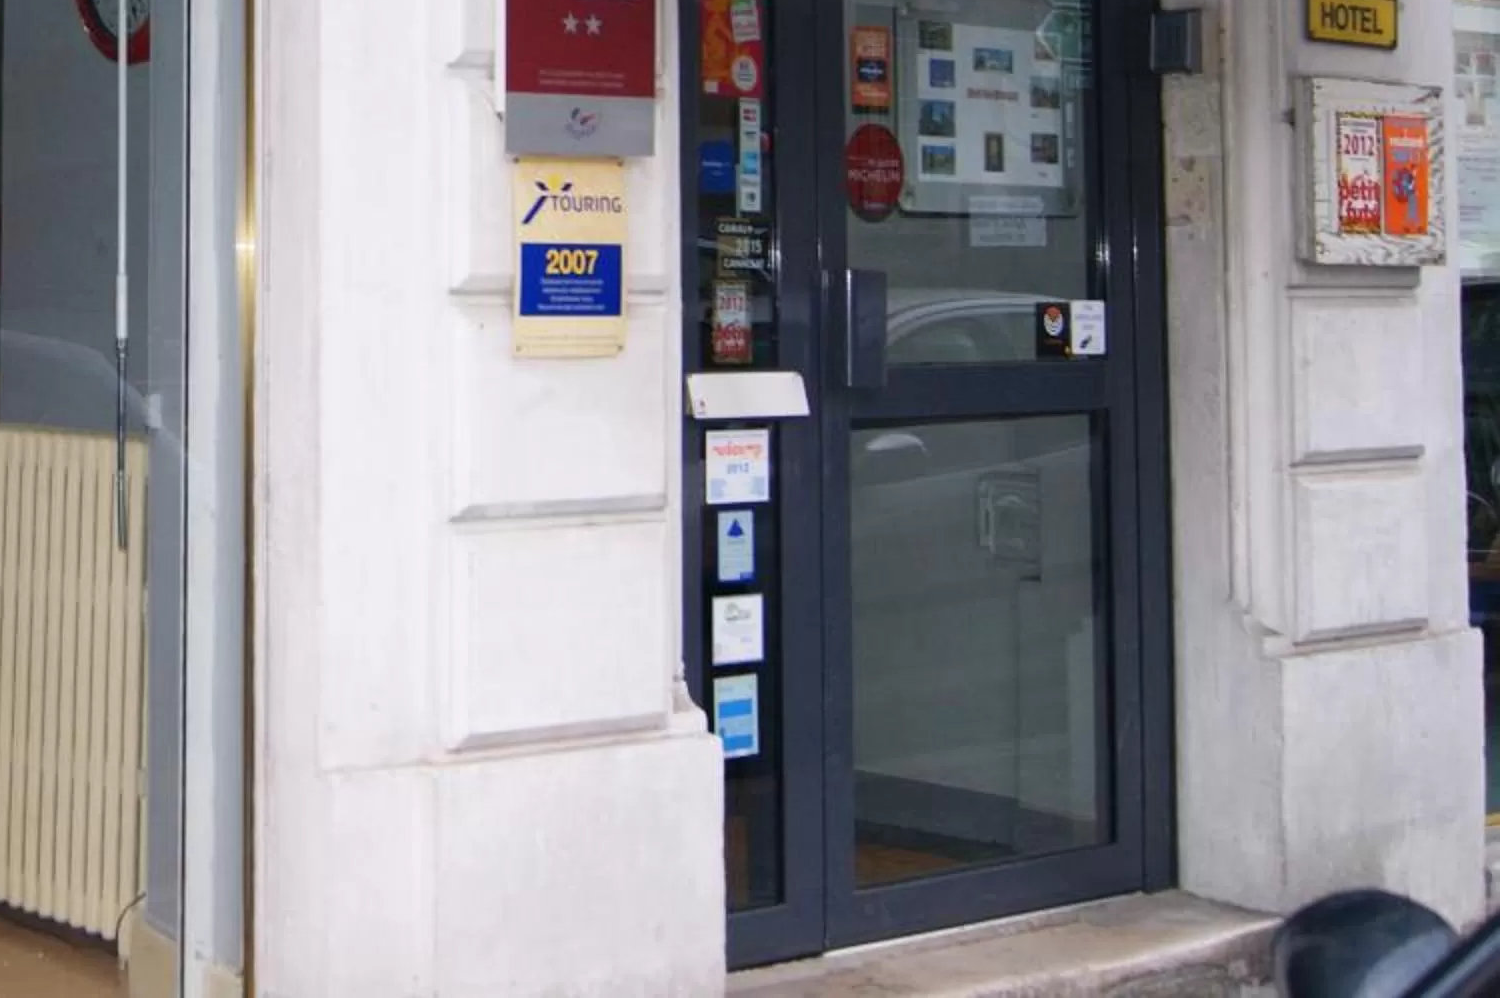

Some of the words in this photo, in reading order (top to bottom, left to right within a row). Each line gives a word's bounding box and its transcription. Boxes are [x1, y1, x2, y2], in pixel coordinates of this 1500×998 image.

[1320, 1, 1384, 35] HOTEL
[1343, 133, 1376, 157] 2012
[551, 195, 623, 213] TOURING
[546, 249, 600, 275] 2007
